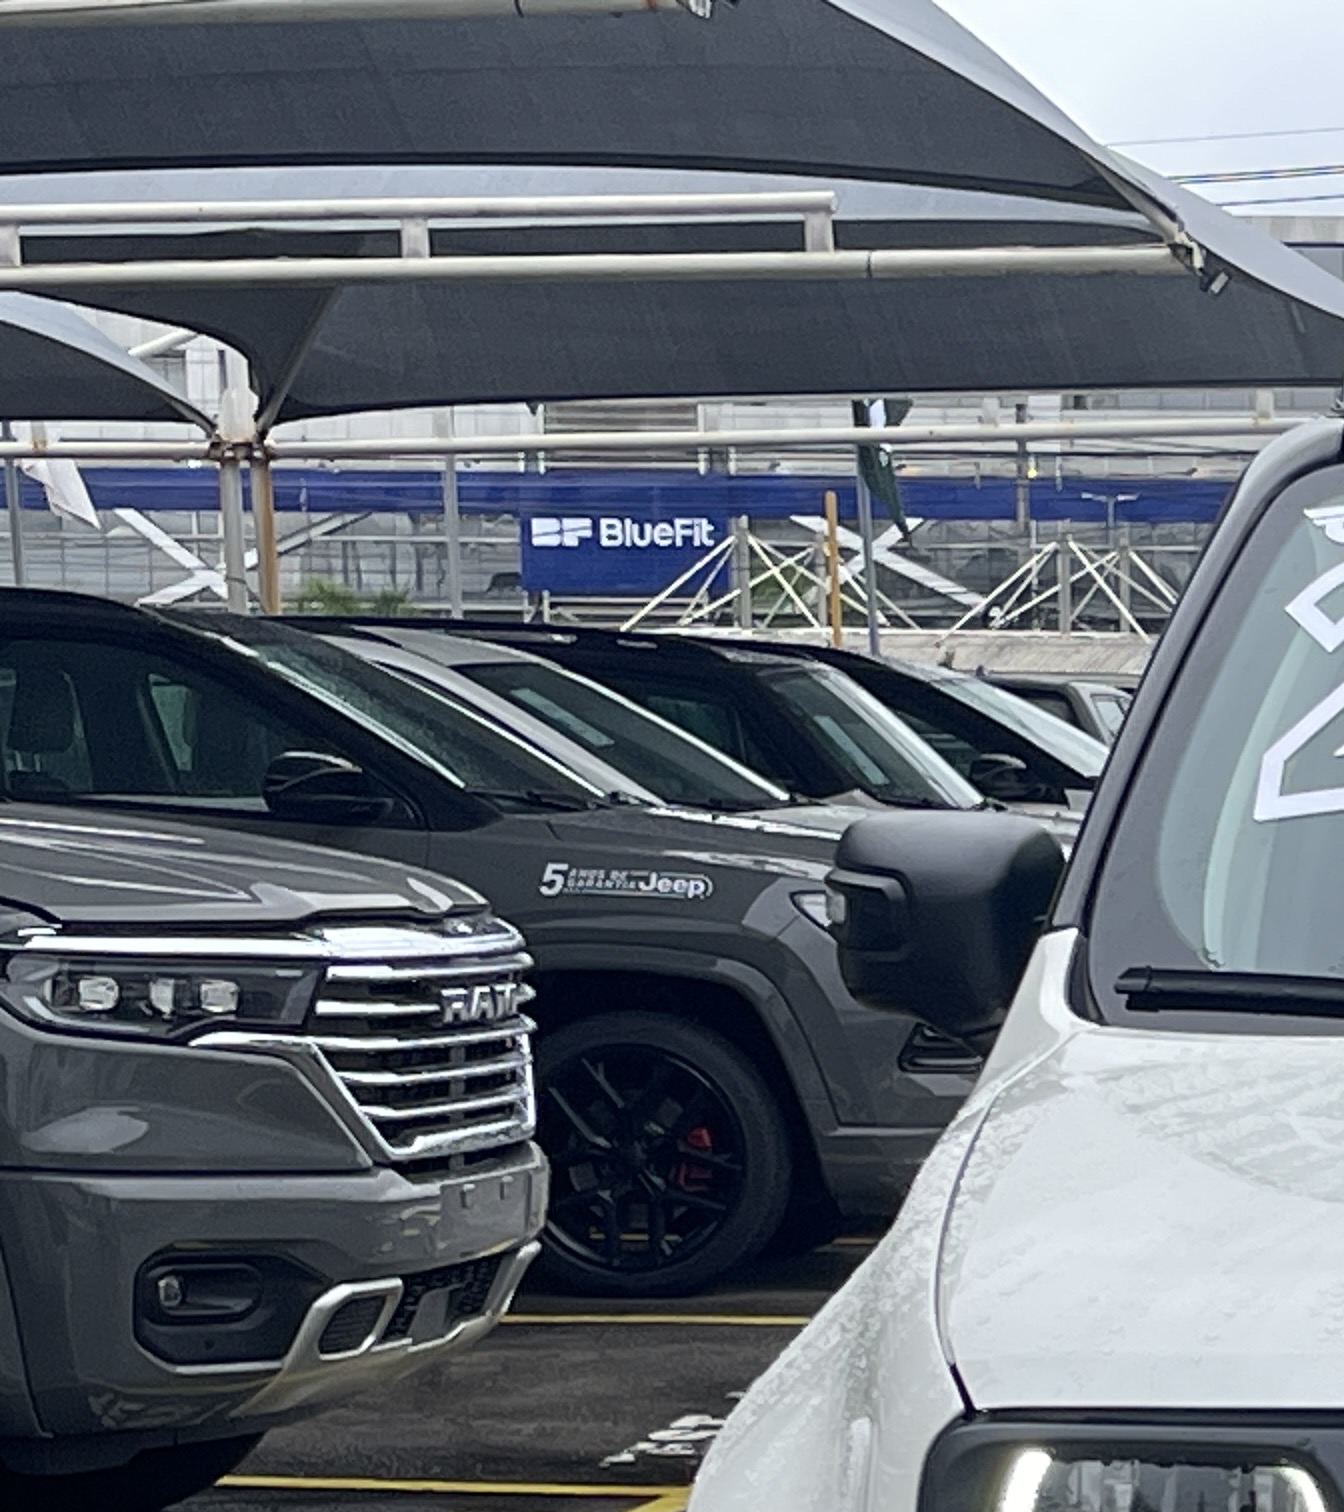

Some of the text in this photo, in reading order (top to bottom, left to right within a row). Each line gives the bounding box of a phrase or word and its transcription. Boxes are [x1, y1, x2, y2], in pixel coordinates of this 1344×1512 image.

[600, 517, 715, 547] BlueFit
[539, 862, 569, 896] 5
[639, 871, 706, 899] Jeep
